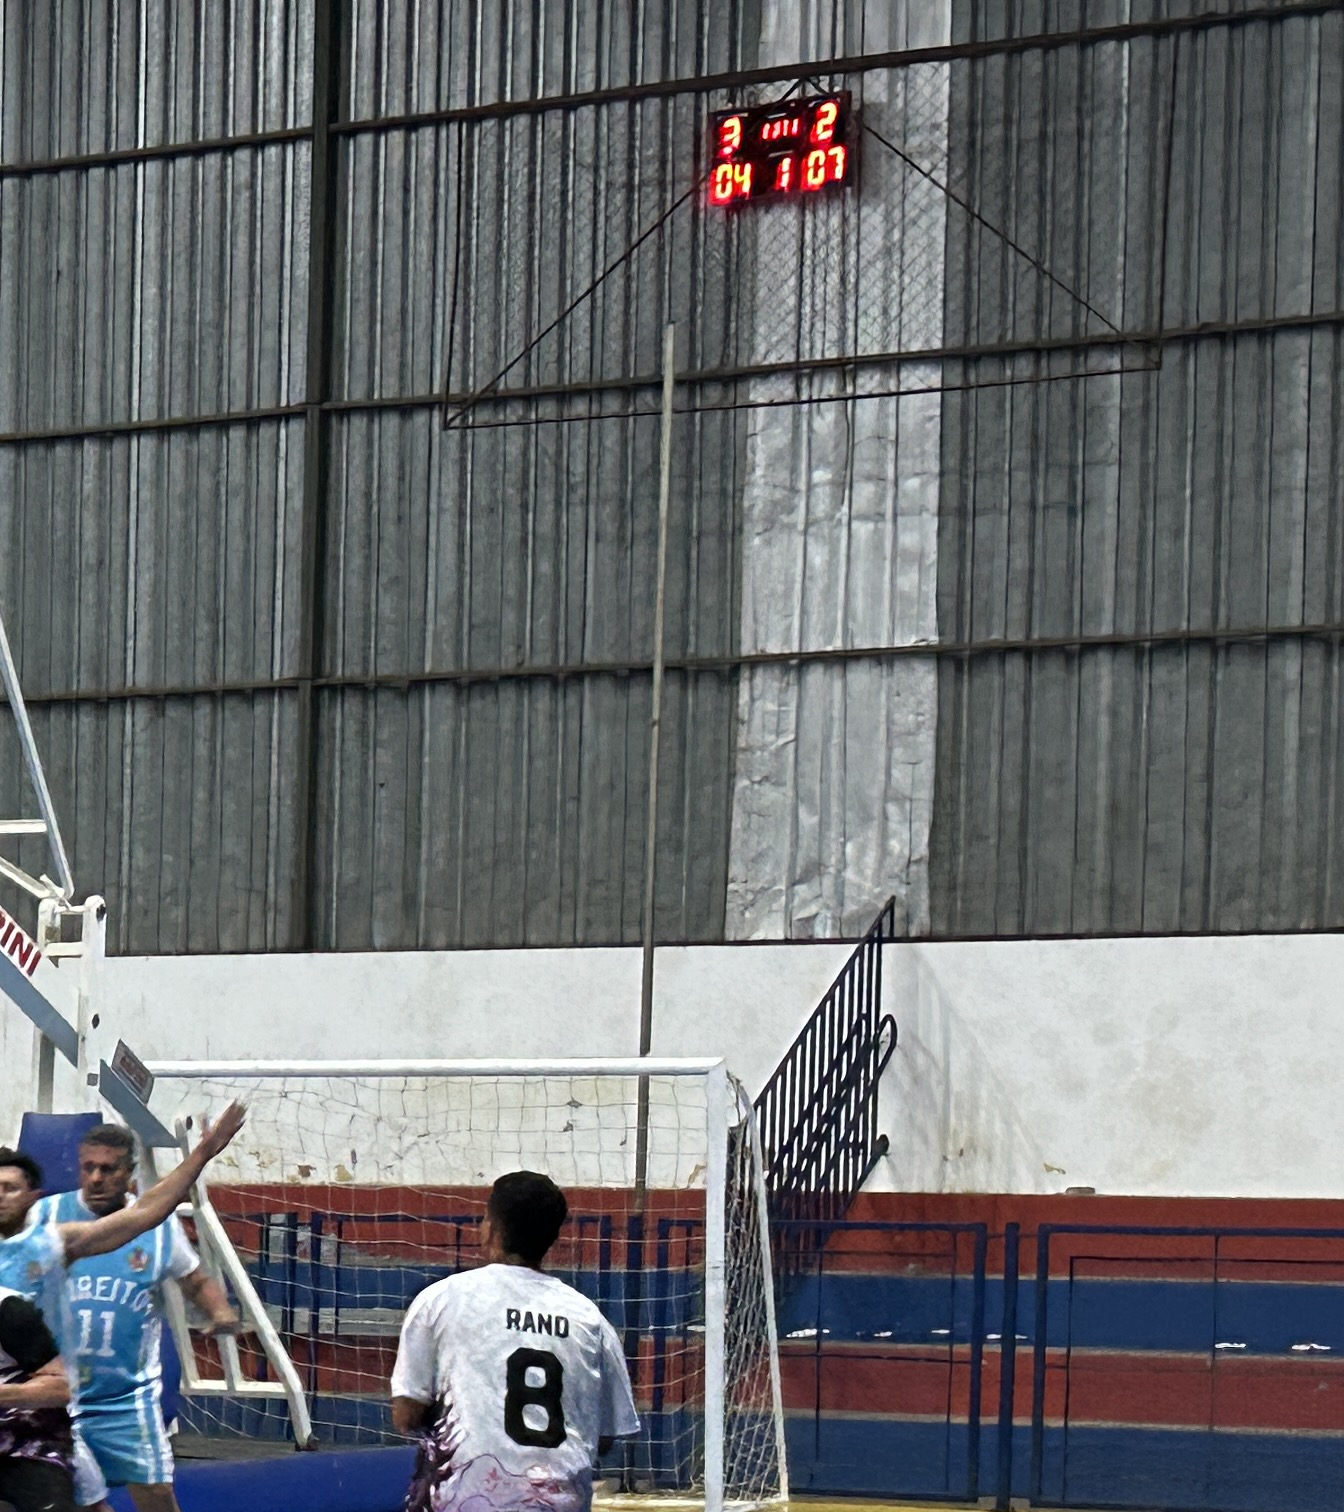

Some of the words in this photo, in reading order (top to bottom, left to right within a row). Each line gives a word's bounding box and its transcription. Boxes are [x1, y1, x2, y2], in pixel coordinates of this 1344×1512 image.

[721, 115, 742, 156] 3
[814, 101, 838, 141] 2
[713, 162, 753, 200] 04
[779, 156, 793, 188] 1
[806, 145, 846, 187] 07
[75, 1308, 116, 1357] 11
[505, 1307, 570, 1339] RAND
[503, 1346, 568, 1450] 8
